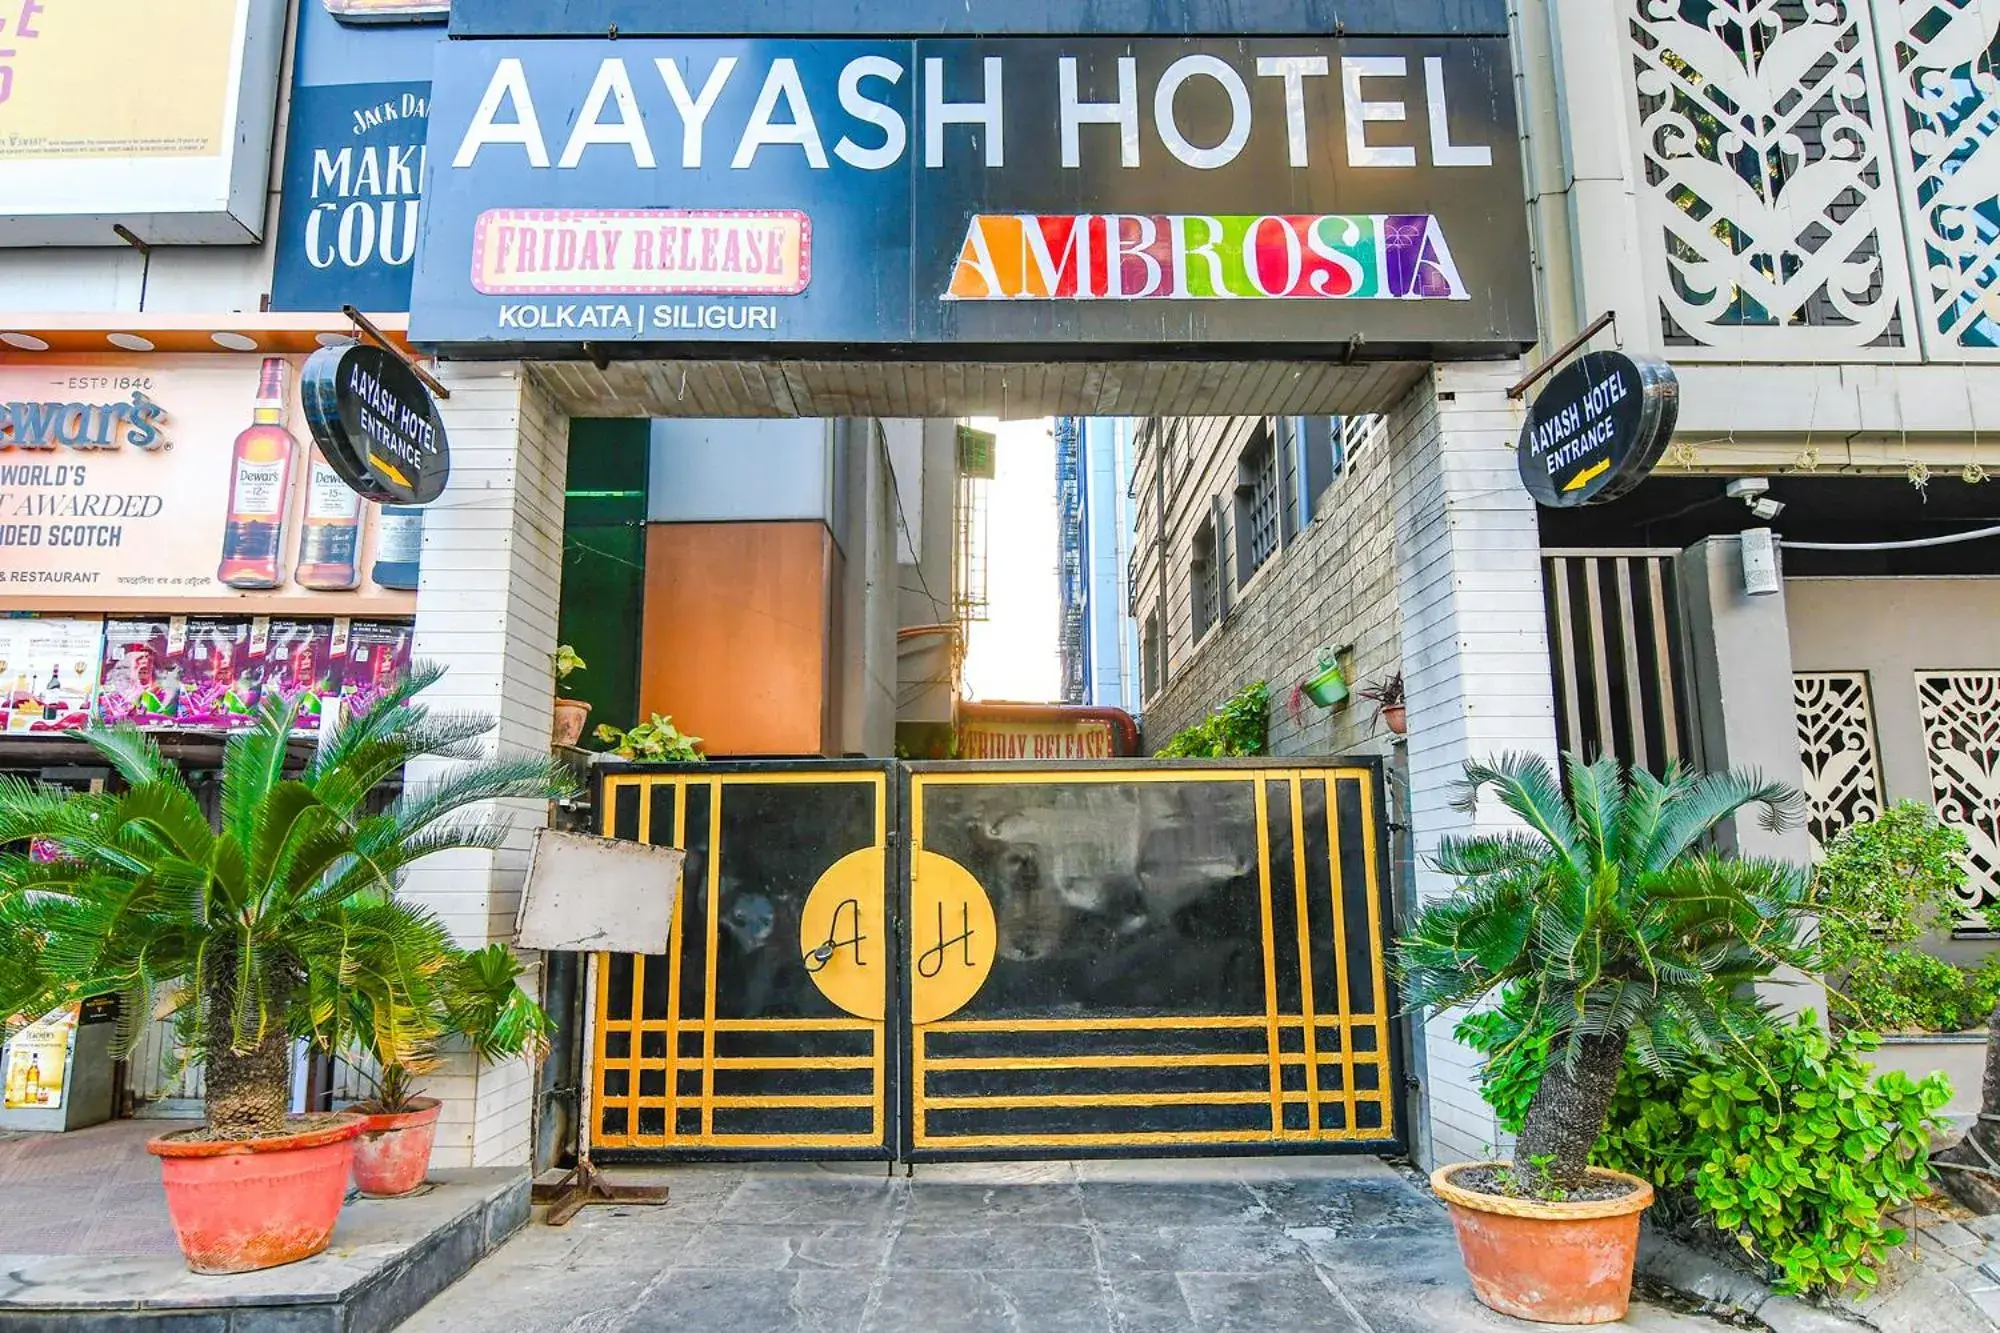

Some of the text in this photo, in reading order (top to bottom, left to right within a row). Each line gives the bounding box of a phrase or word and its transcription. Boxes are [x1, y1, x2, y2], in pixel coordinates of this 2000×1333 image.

[352, 101, 397, 135] JACK
[452, 54, 1493, 170] AAYASH HOTEL
[494, 225, 787, 275] FRIDAY RELEASE
[939, 213, 1471, 301] AMBROSIA
[499, 304, 632, 330] KOLKATA
[652, 304, 778, 331] SILIGURI
[349, 362, 438, 455] AAYASH HOTEL
[1529, 369, 1628, 458] AAYASH HOTEL
[359, 406, 423, 471] ENTRANCE
[1546, 415, 1615, 475] ENTRANCE
[0, 464, 87, 487] WORLD'S
[12, 493, 164, 518] AWARDED
[47, 525, 123, 547] SCOTCH
[10, 571, 101, 584] RESTAURANT
